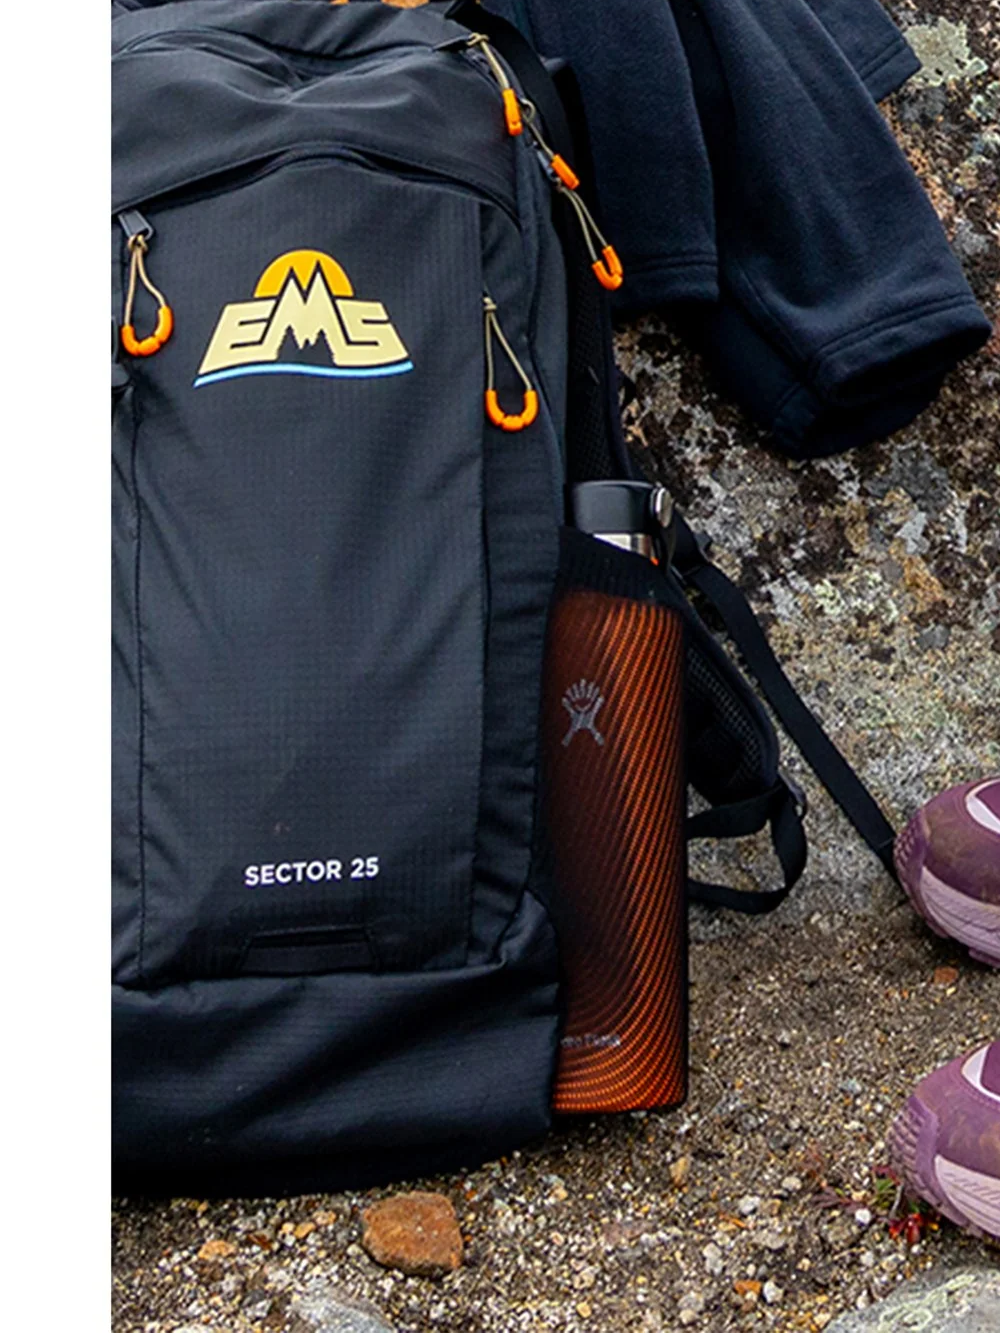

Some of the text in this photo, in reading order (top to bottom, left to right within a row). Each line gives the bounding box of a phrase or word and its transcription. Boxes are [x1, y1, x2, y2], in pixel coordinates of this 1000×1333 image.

[198, 270, 409, 375] EMS
[244, 856, 379, 886] SECTOR 25
